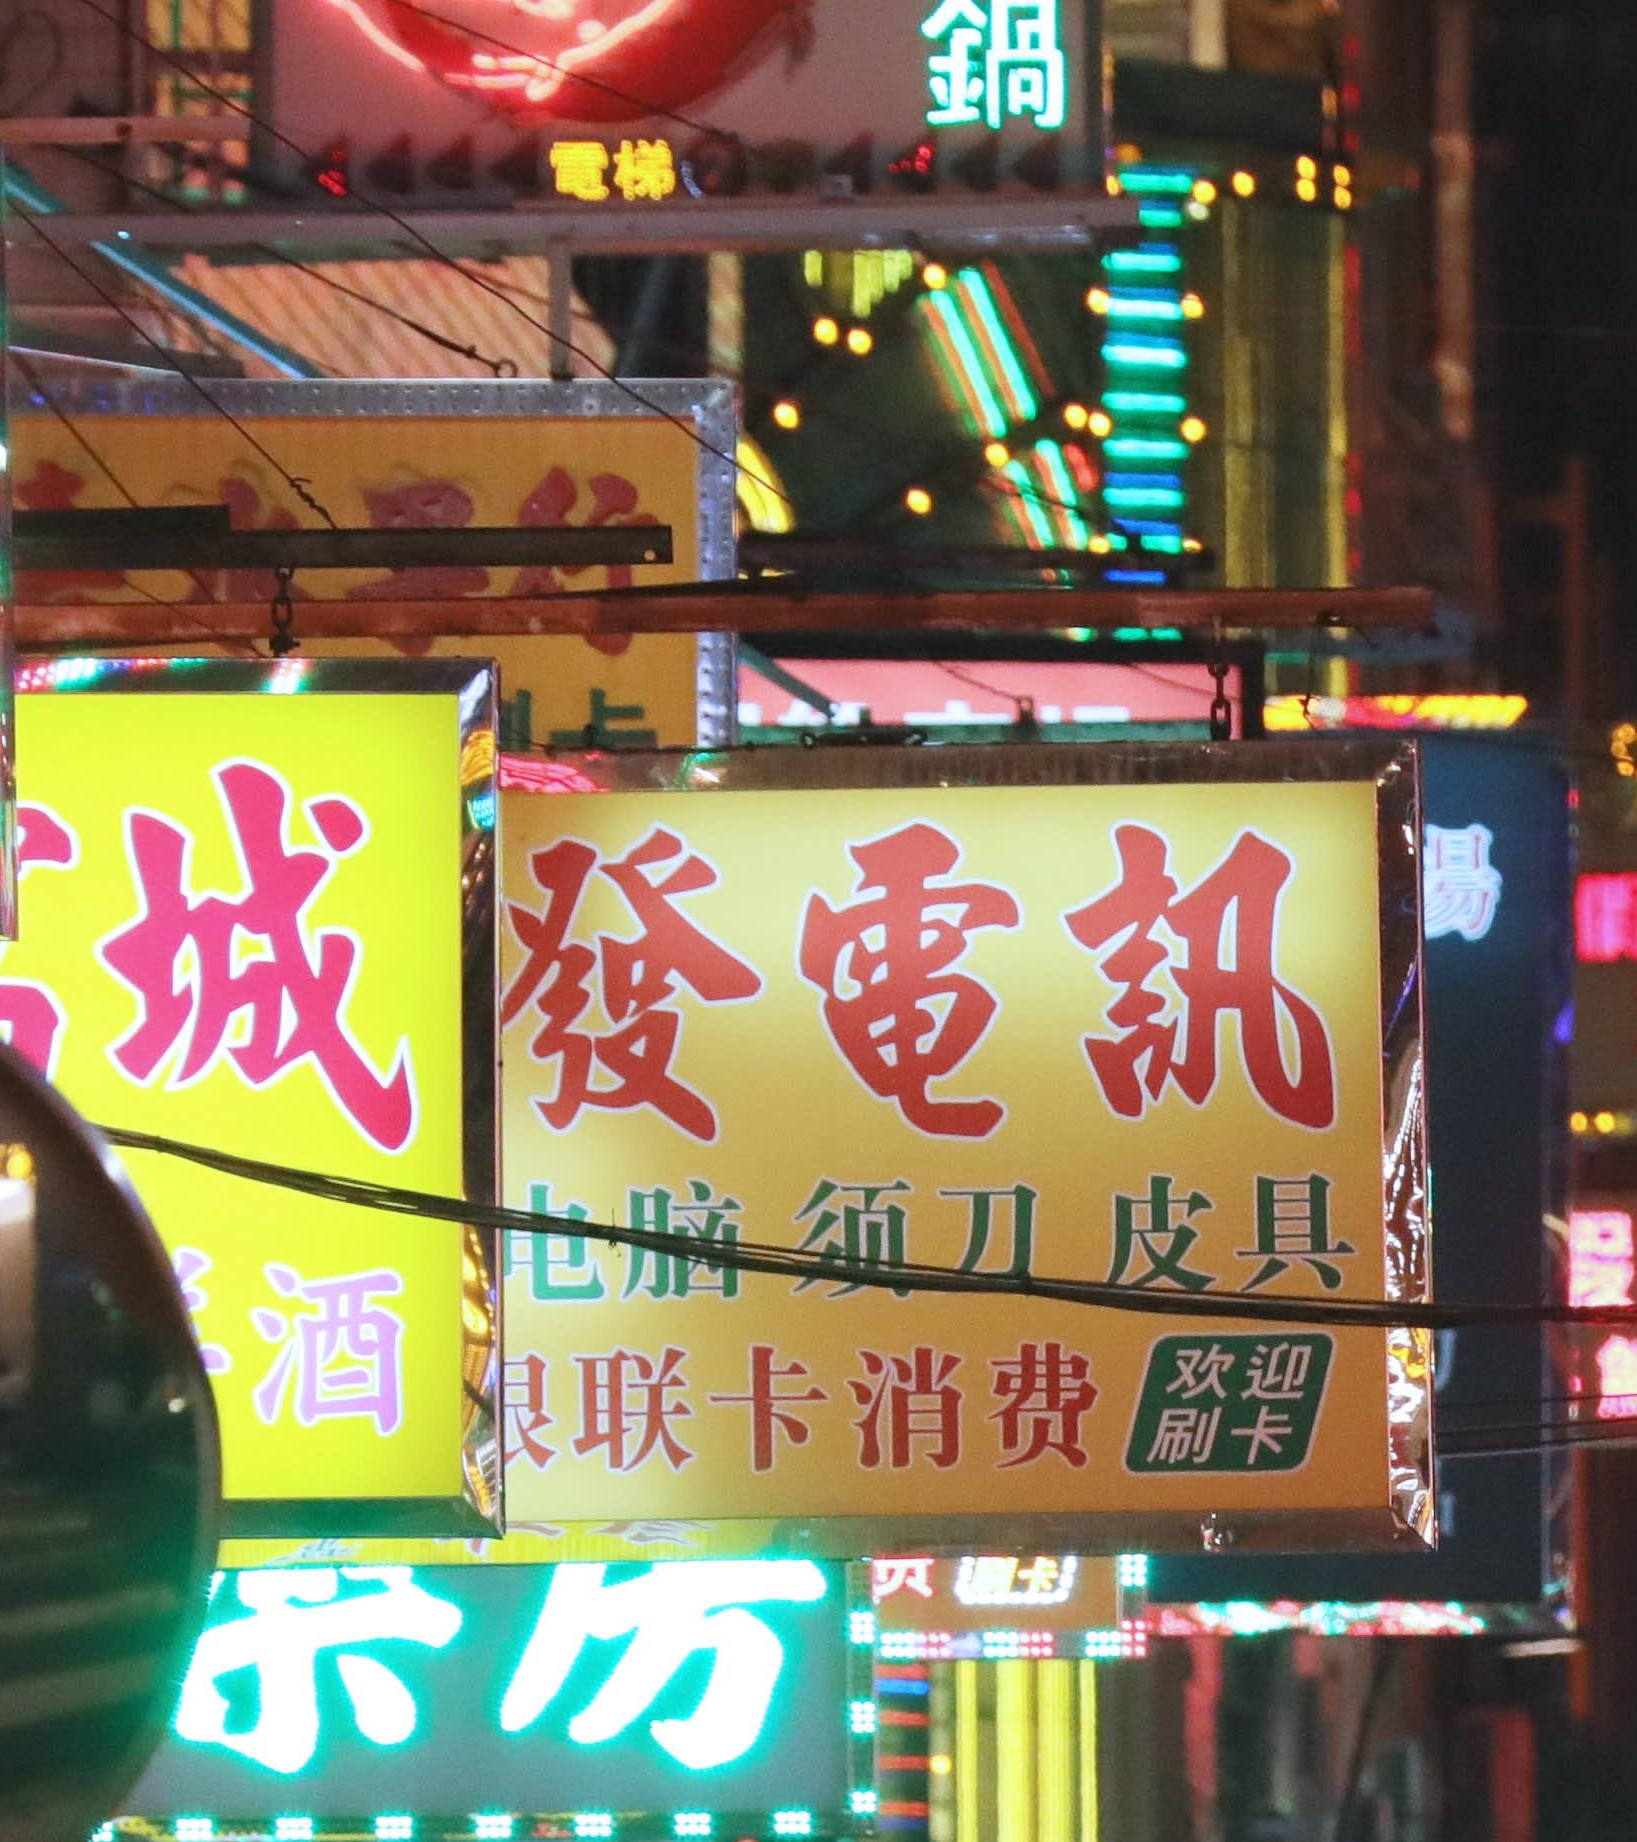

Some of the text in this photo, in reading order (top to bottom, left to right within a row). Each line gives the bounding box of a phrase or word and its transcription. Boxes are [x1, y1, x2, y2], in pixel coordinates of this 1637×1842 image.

[549, 140, 676, 201] 電梯
[501, 822, 1337, 1142] 發電訊
[1166, 1342, 1313, 1400] 欢迎
[1146, 1404, 1293, 1466] 刷卡
